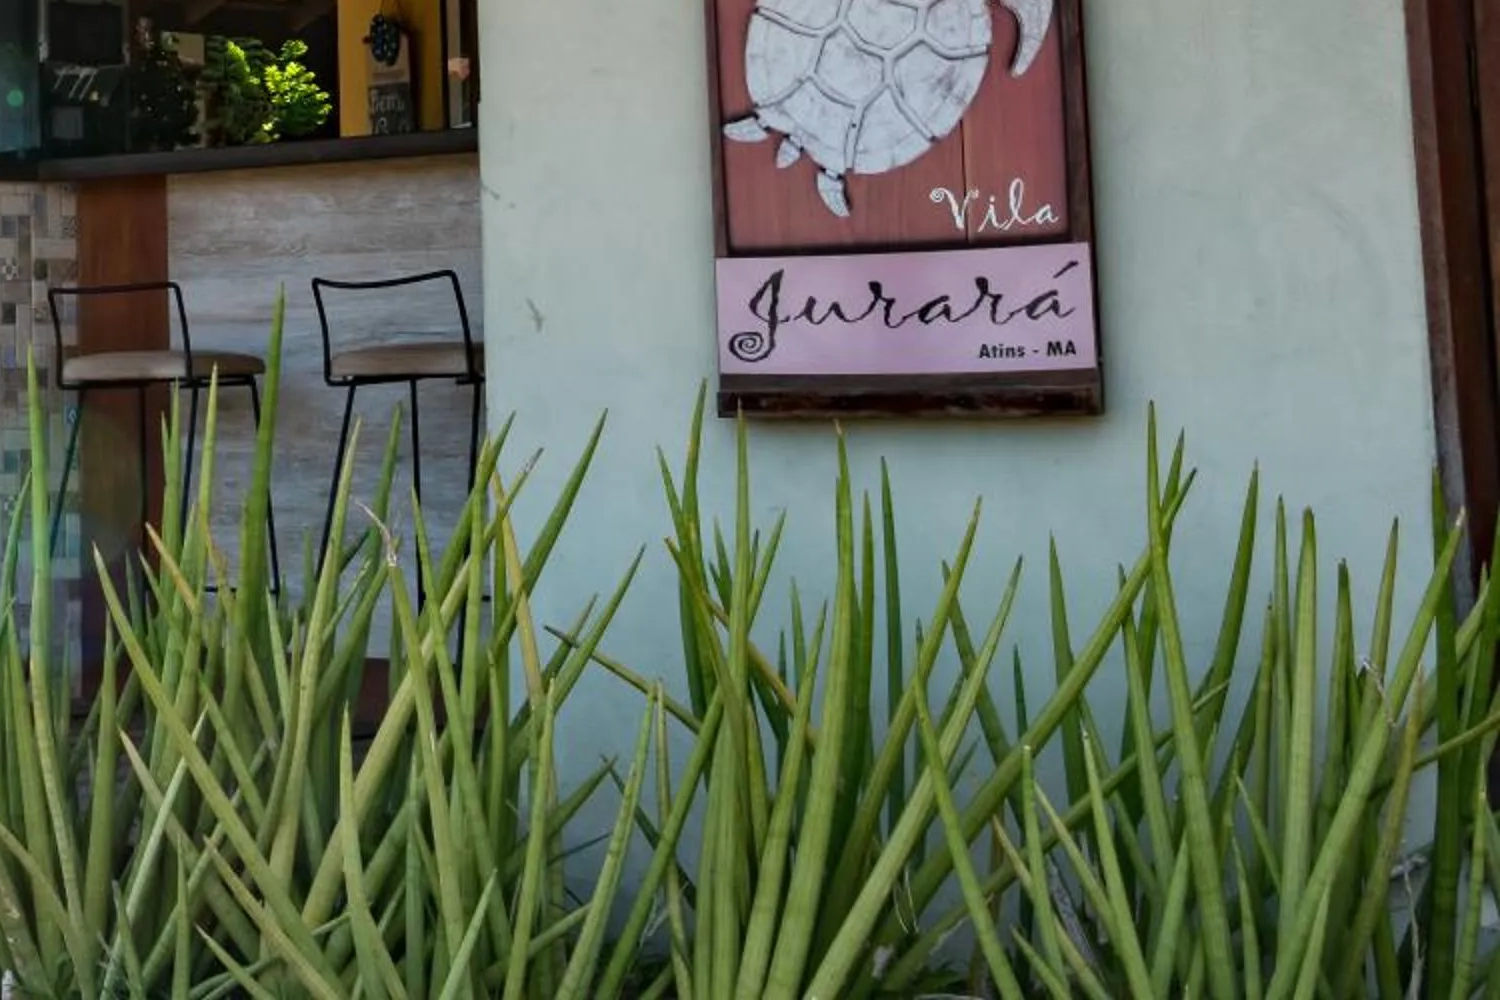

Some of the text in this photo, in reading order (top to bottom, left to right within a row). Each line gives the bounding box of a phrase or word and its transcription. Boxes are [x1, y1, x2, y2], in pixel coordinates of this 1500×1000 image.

[929, 178, 1059, 232] Vila
[728, 261, 1079, 363] Jurará
[979, 343, 1026, 359] Atins
[1047, 339, 1077, 357] MA
